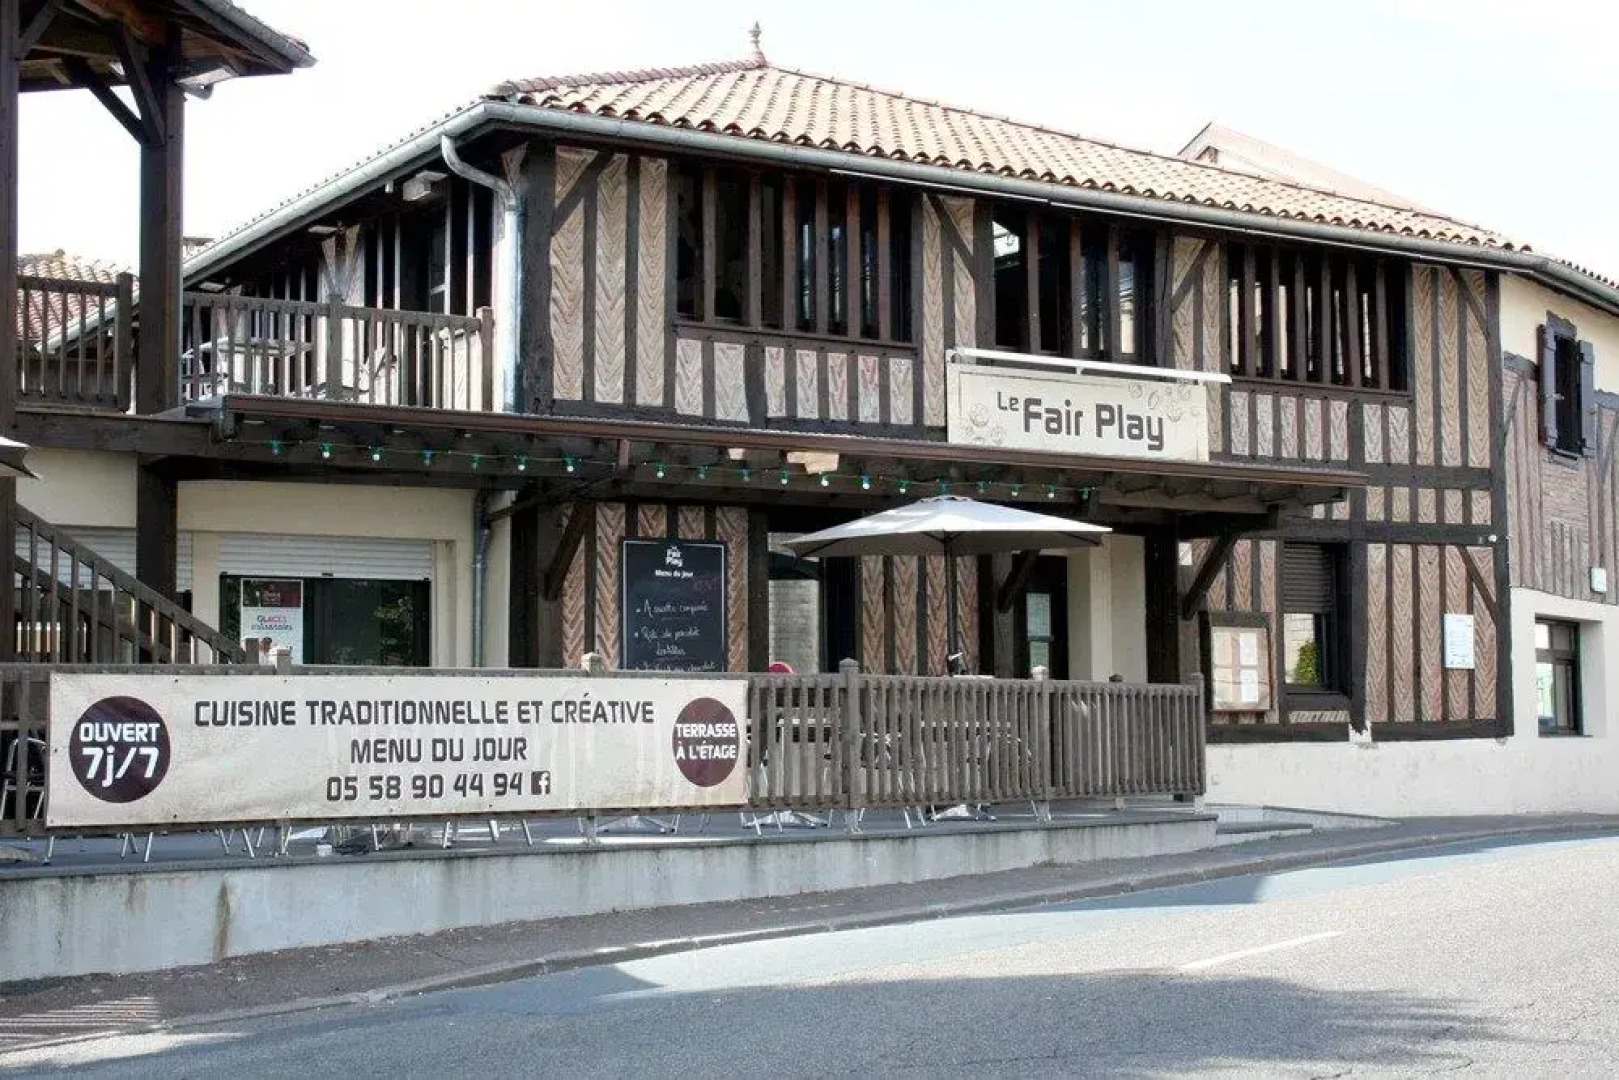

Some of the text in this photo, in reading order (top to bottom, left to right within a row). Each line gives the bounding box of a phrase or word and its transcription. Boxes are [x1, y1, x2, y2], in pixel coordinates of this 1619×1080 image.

[996, 391, 1164, 450] Le Fair Play
[195, 692, 655, 727] CUISINE TRADITIONNELLE ET CRÉATIVE
[79, 723, 160, 743] OUVERT
[675, 723, 737, 738] TERRASSE
[350, 735, 527, 764] MENU DU JOUR
[676, 740, 737, 760] À L'ÉTAGE
[81, 744, 160, 788] 7j/7
[326, 775, 358, 802] 05
[369, 774, 401, 800] 58
[412, 773, 444, 799] 90
[453, 773, 484, 798] 44
[493, 772, 523, 797] 94
